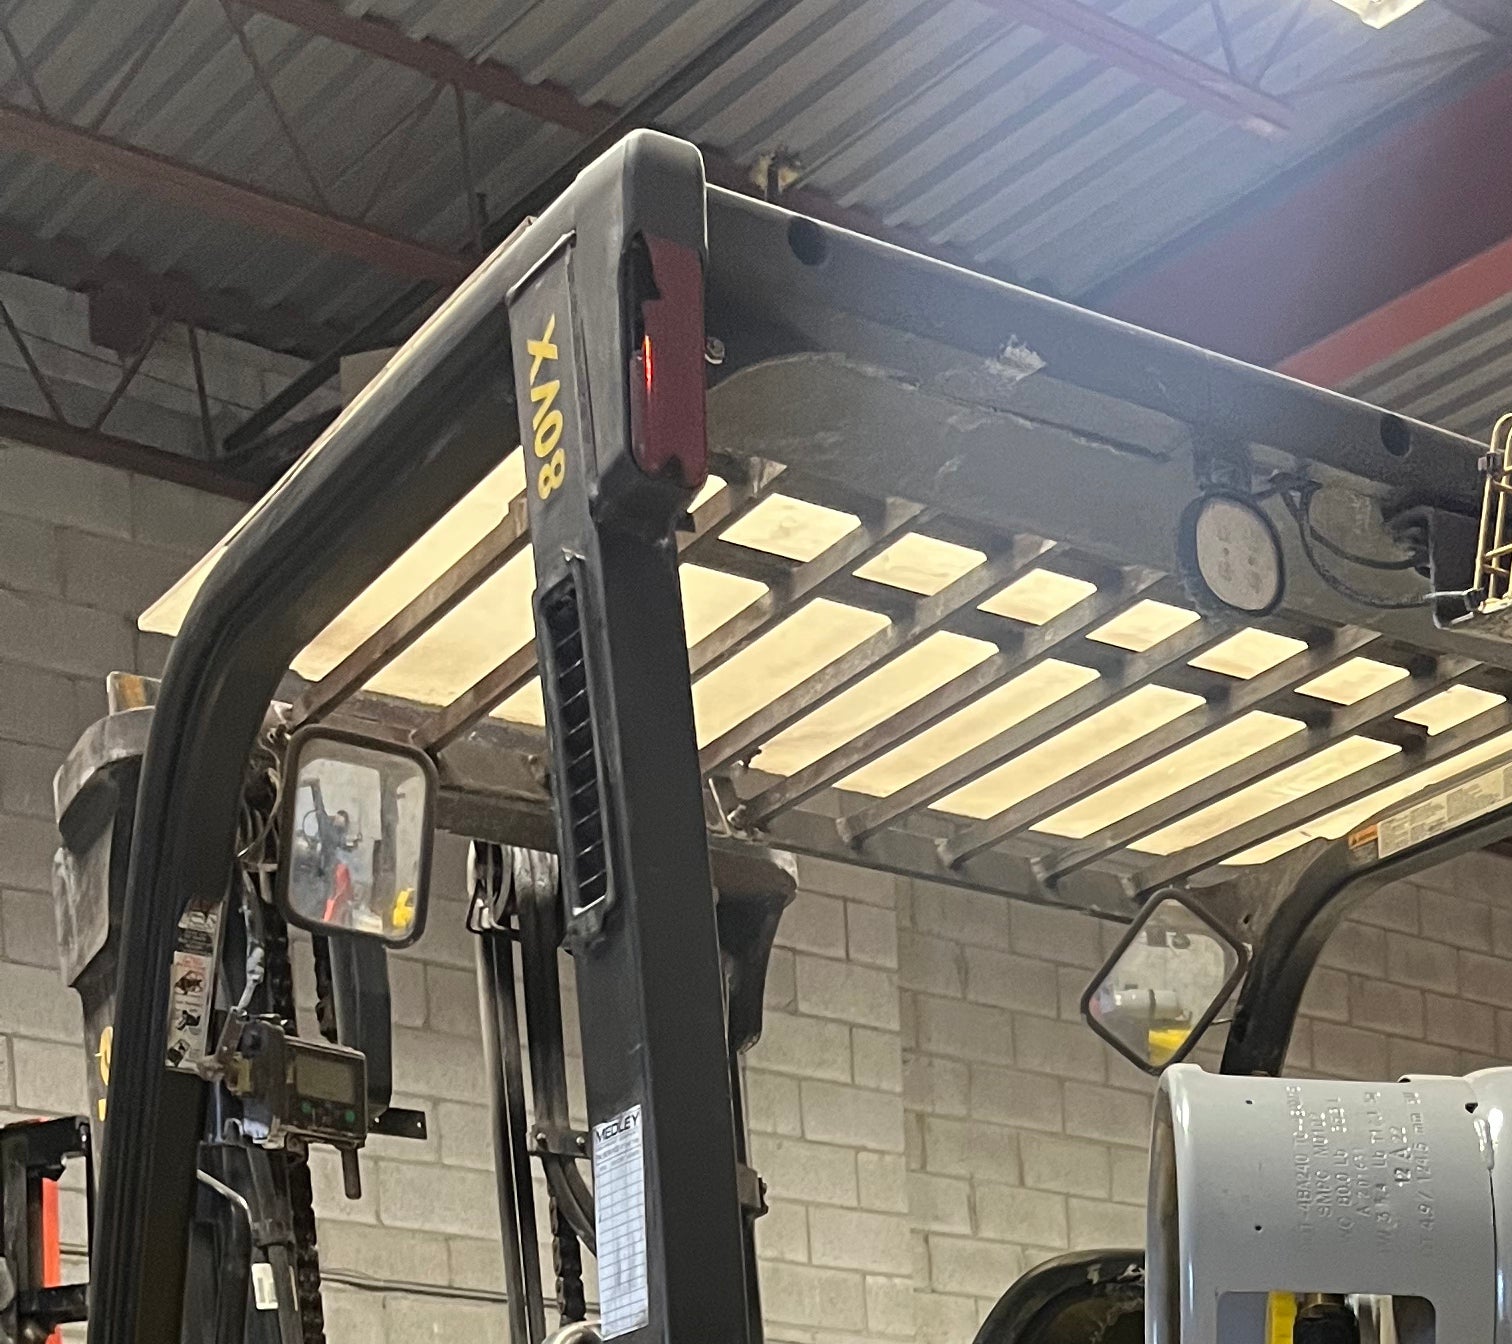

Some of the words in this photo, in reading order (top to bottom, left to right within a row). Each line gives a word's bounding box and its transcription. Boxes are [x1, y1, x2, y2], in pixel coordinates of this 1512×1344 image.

[527, 313, 566, 500] 80VX
[595, 1111, 640, 1143] MEDLEY
[1336, 1172, 1353, 1207] 80.0
